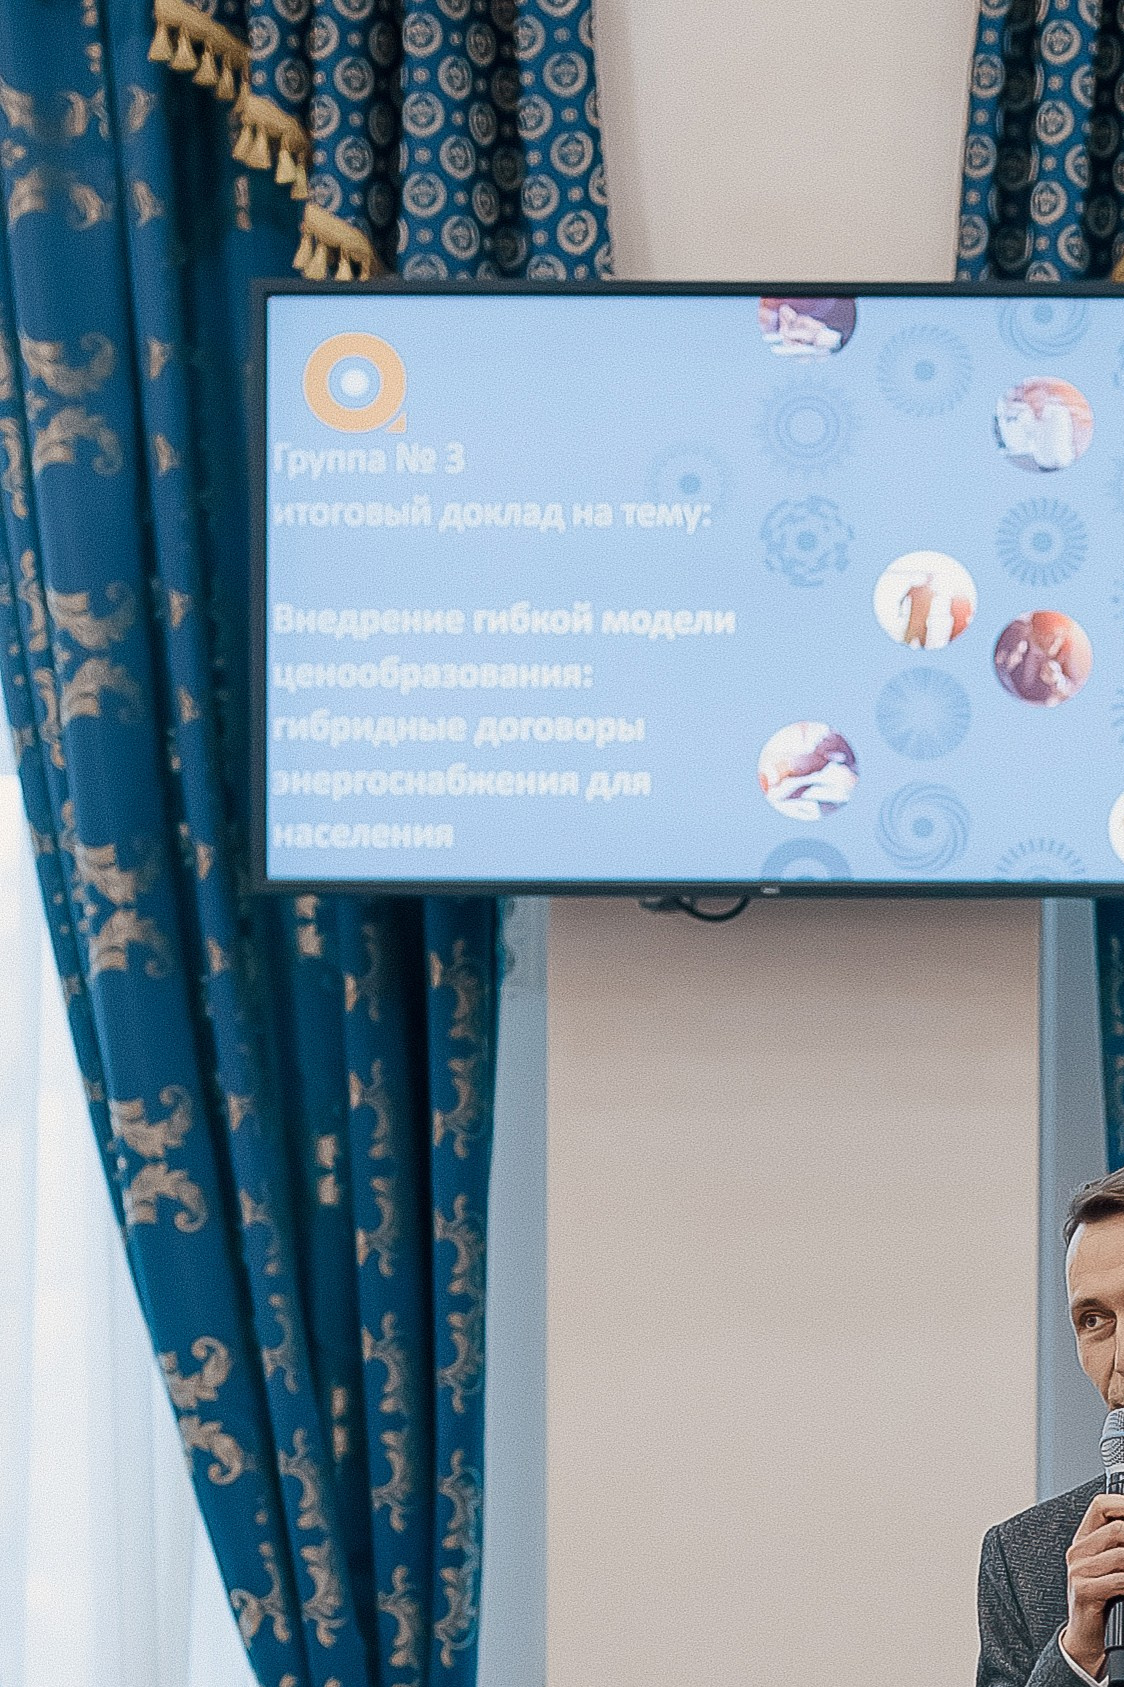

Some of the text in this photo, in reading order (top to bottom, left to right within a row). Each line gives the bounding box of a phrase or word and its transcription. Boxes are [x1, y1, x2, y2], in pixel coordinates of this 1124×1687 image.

[272, 442, 465, 480] Группа № 3
[272, 496, 713, 534] итоговый доклад на тему:
[272, 602, 736, 640] Внедрение гибкой модели
[272, 656, 594, 695] ценообразования:
[272, 708, 645, 749] гибридные договоры
[272, 764, 653, 801] энергоснабжения для
[272, 821, 454, 849] населения
